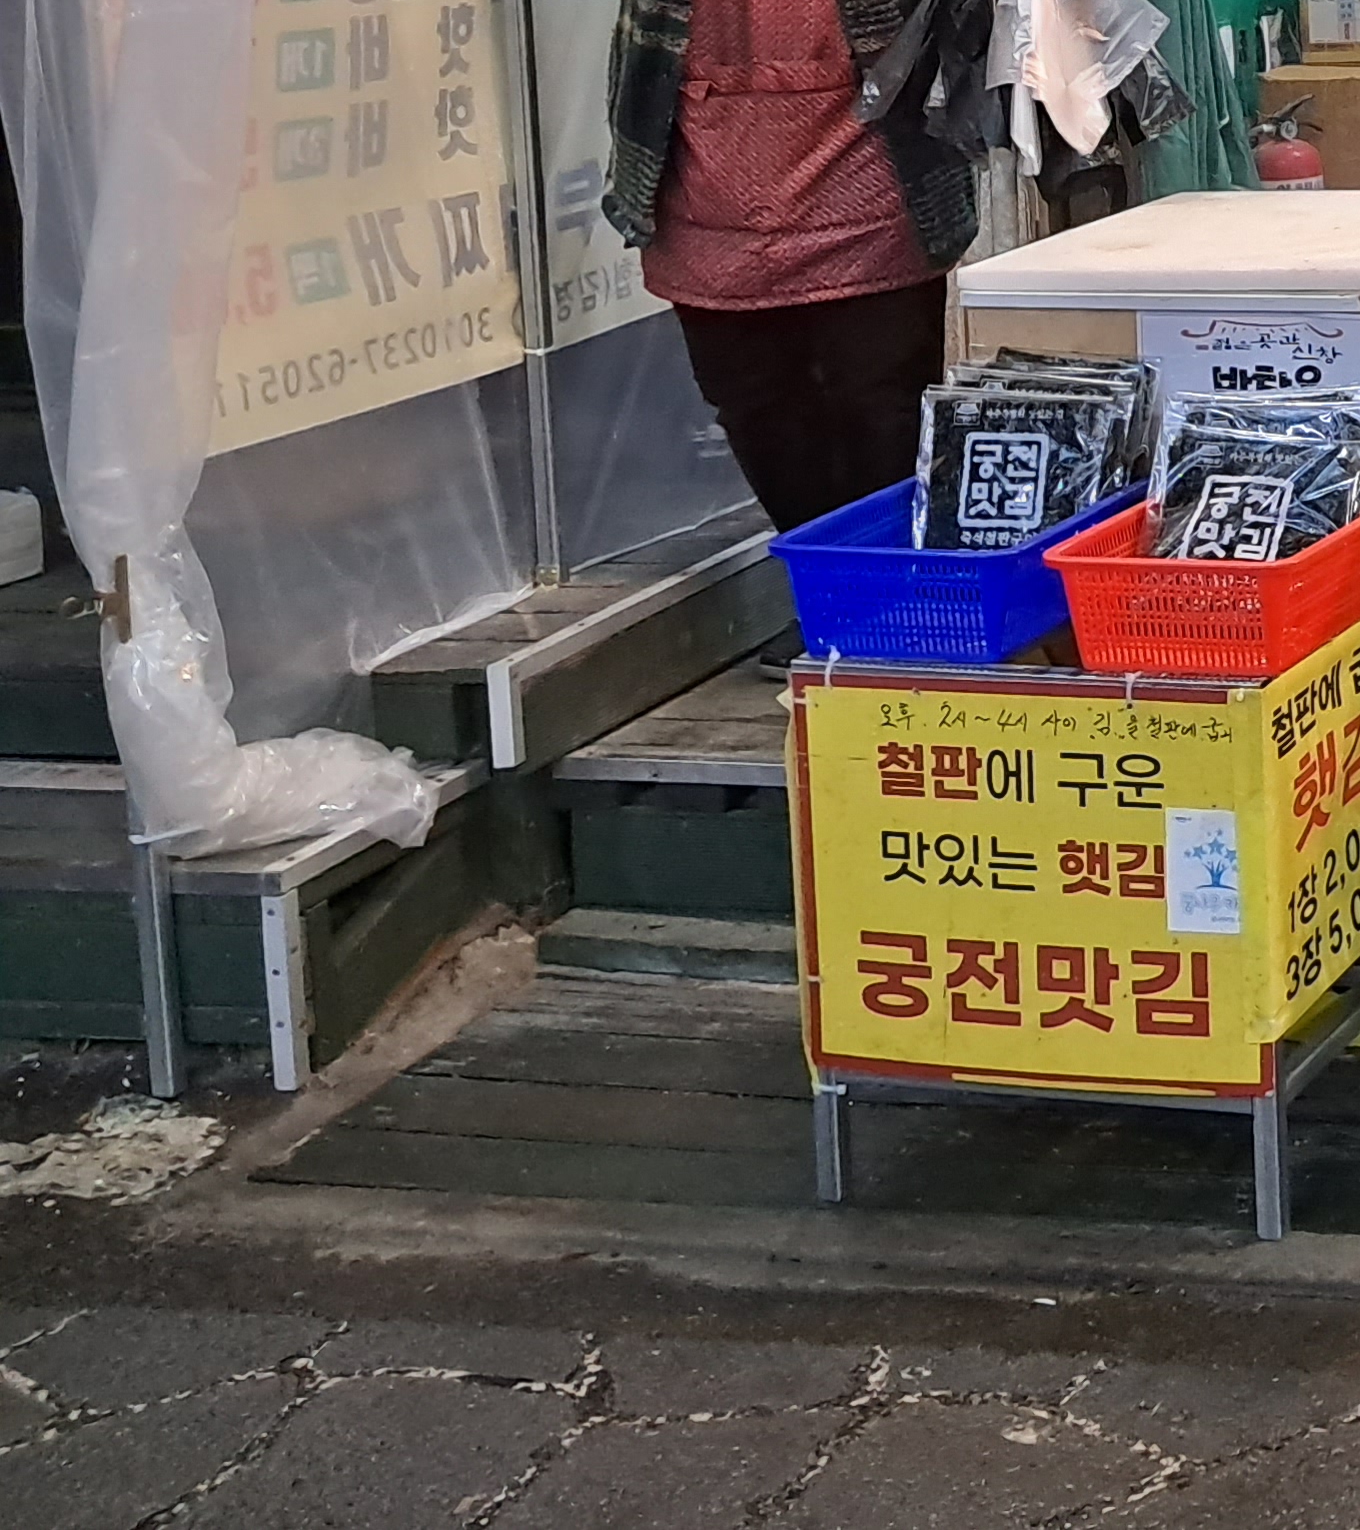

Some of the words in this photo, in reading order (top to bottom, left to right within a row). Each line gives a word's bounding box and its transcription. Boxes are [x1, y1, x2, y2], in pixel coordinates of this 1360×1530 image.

[1271, 659, 1342, 759] 철판에
[876, 741, 1035, 803] 철판에
[1056, 751, 1166, 810] 구운
[880, 830, 1038, 892] 맛있는
[1056, 839, 1166, 900] 햇김
[1288, 865, 1318, 933] 1장
[856, 928, 1212, 1038] 궁전맛김
[1286, 927, 1322, 1001] 3장
